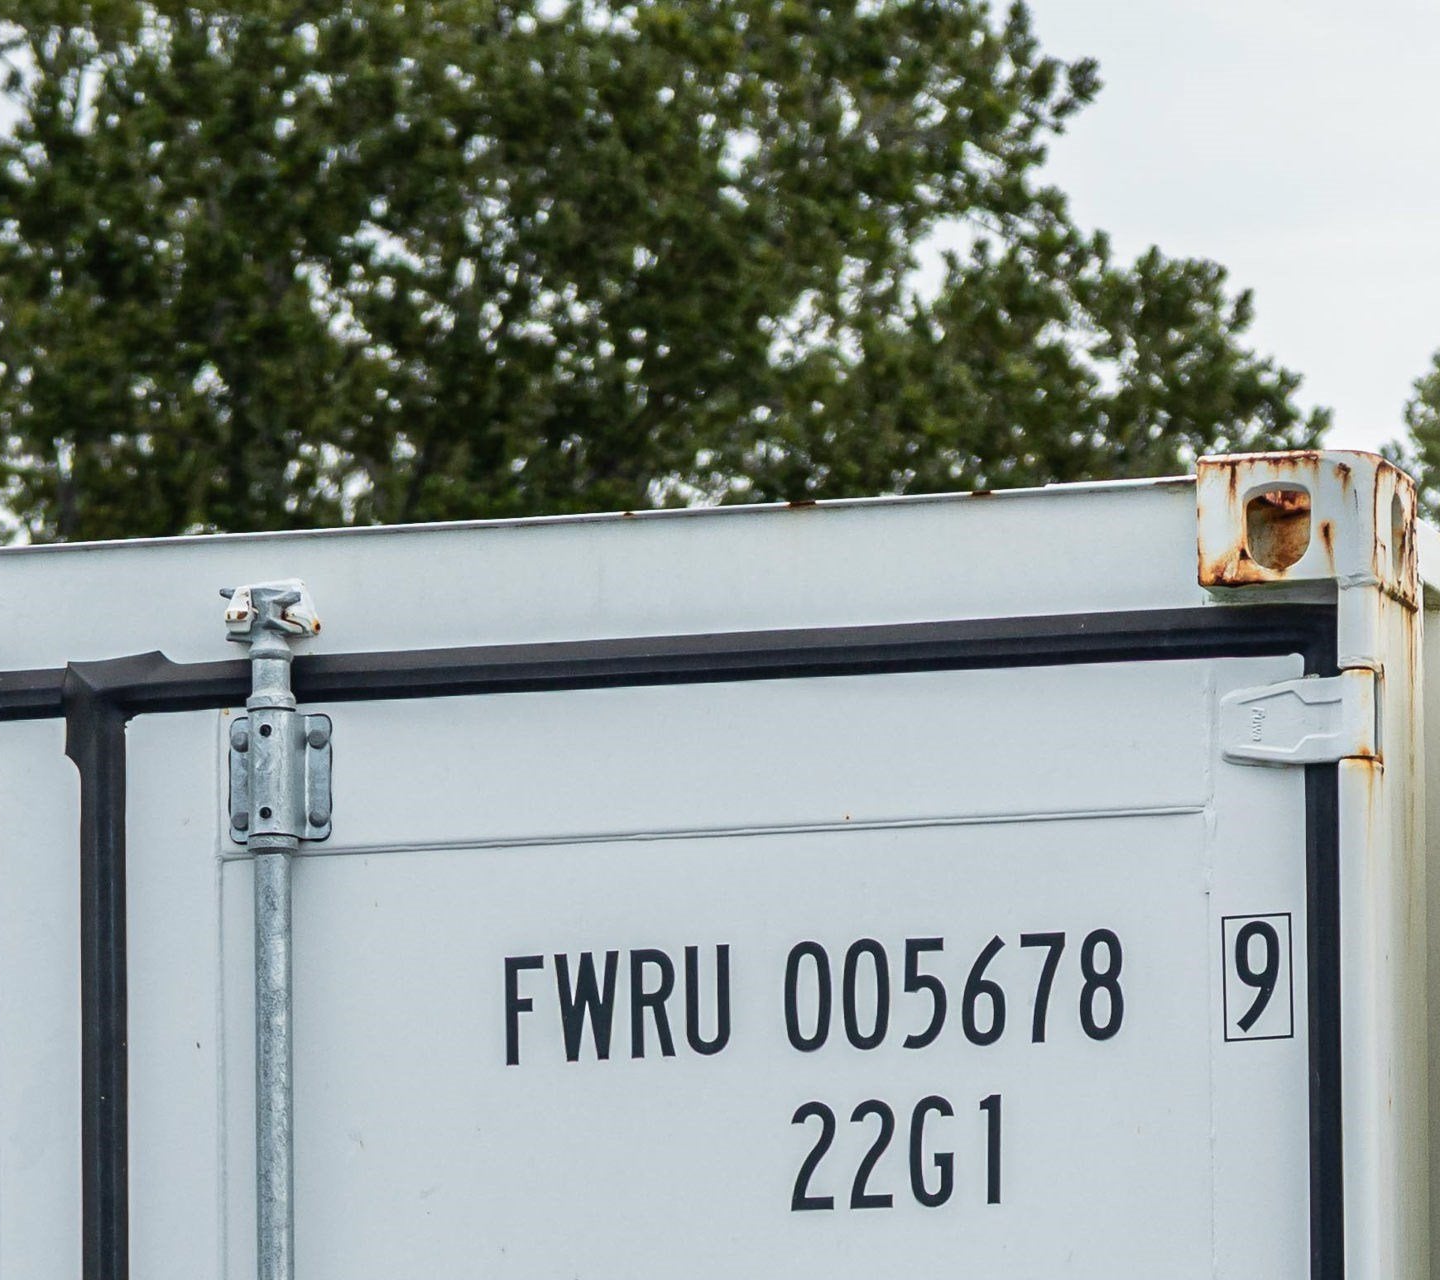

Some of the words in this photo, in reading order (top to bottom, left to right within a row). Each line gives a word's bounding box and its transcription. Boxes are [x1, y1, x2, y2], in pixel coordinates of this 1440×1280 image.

[505, 945, 730, 1065] FWRU
[785, 929, 1123, 1052] 005678
[1235, 920, 1281, 1033] 9
[791, 1095, 1001, 1211] 22G1
